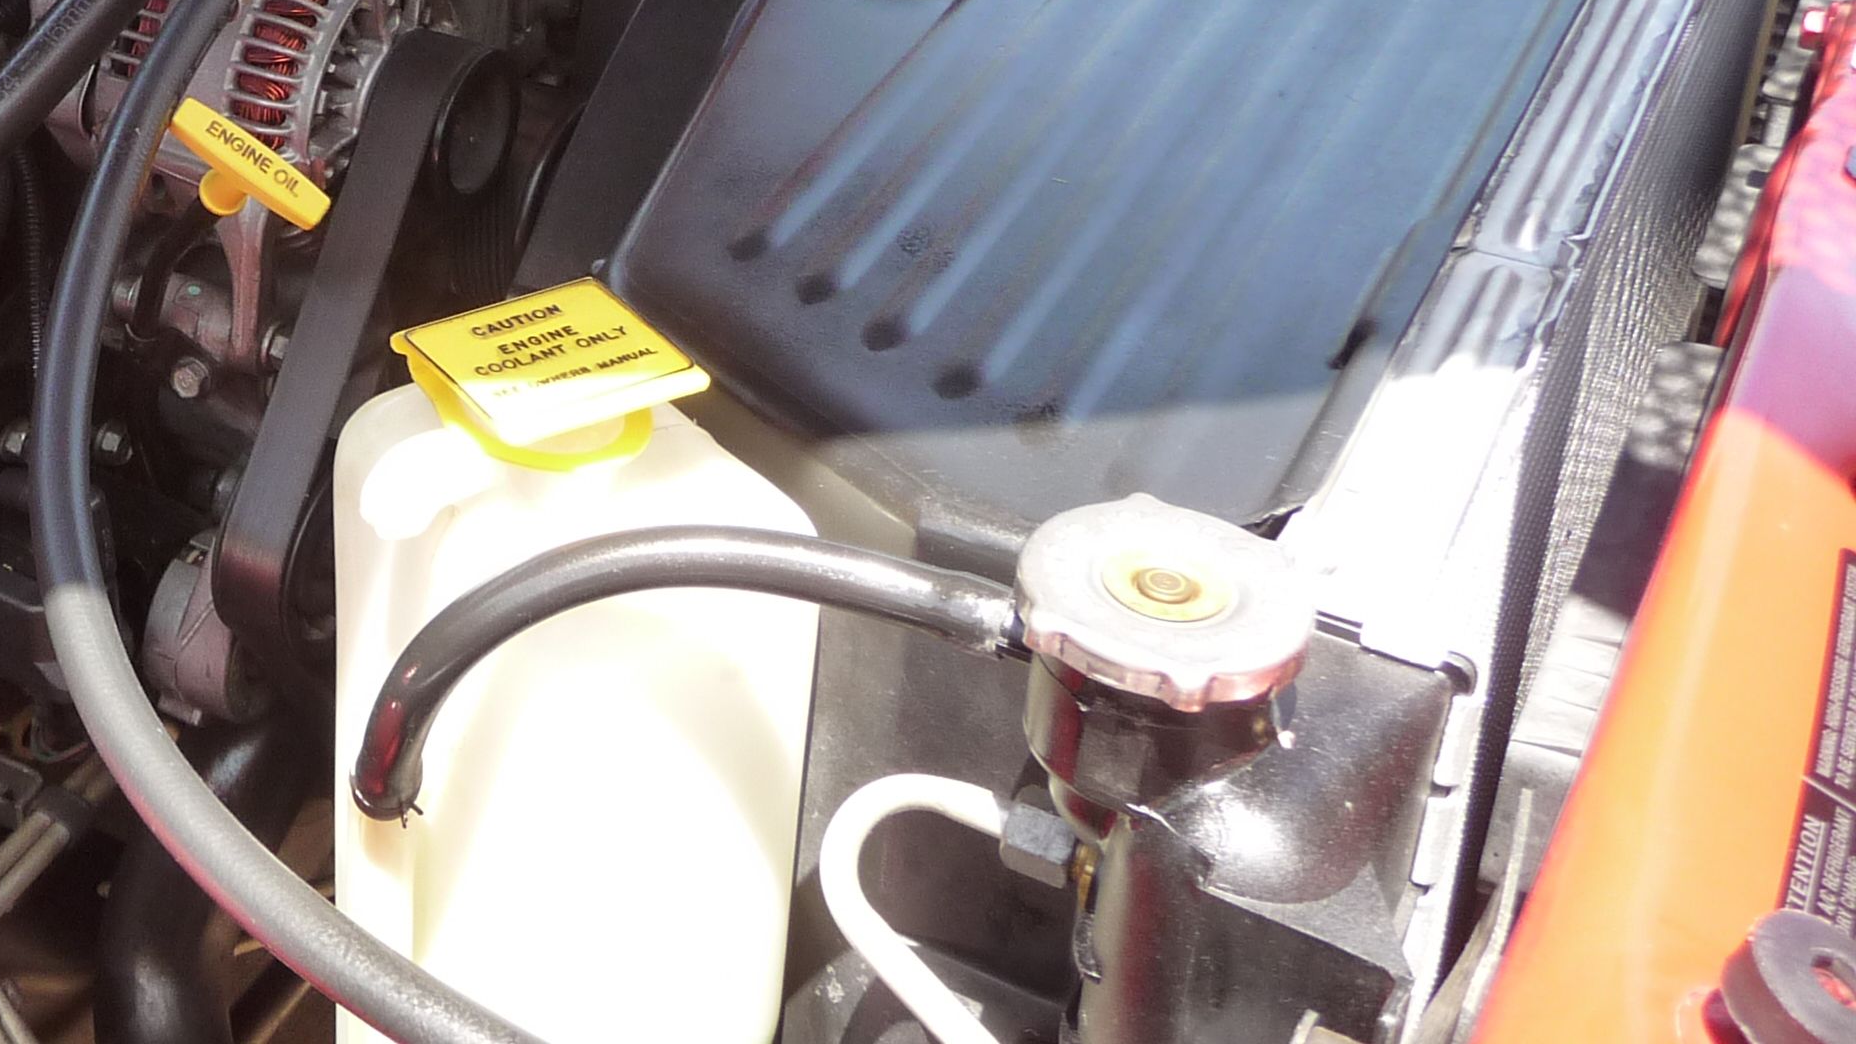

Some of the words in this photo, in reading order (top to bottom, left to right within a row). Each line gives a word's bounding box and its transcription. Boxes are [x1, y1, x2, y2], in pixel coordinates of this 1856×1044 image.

[205, 120, 274, 174] ENGINE
[273, 169, 300, 197] OIL
[472, 304, 562, 338] CAUTION
[497, 325, 580, 355] ENGINE
[474, 344, 567, 377] COOLANT
[576, 325, 628, 349] ONLY
[596, 347, 659, 371] MANUAL
[1785, 814, 1822, 910] TENTION
[1822, 805, 1854, 892] REFRIGERANT
[1817, 888, 1838, 916] A/C
